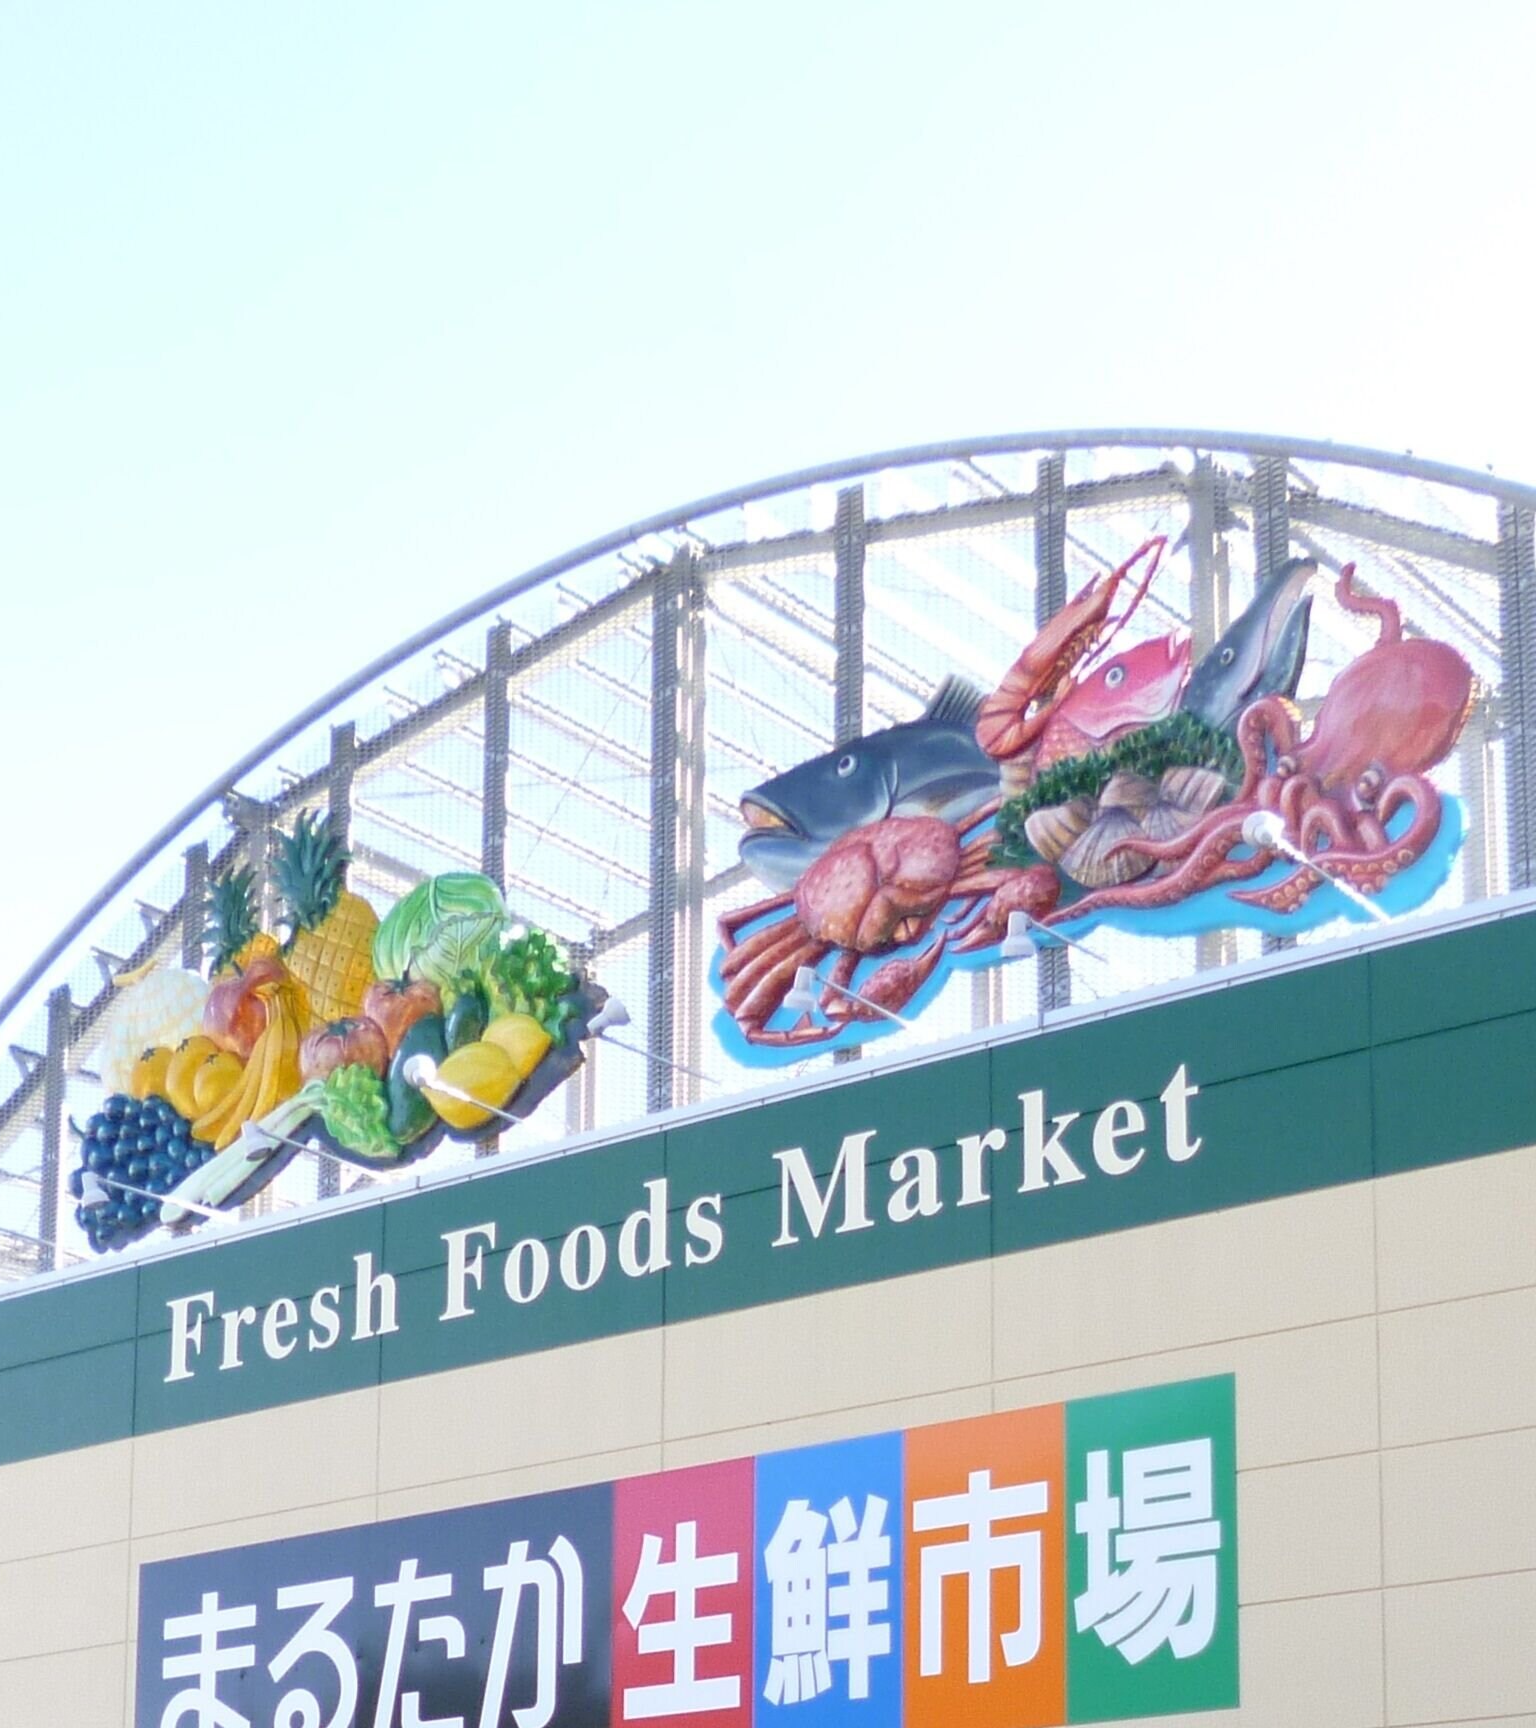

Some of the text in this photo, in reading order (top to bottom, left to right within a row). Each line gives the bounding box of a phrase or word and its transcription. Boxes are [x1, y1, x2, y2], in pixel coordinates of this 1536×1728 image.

[163, 1063, 1204, 1384] Fresh Foods Market
